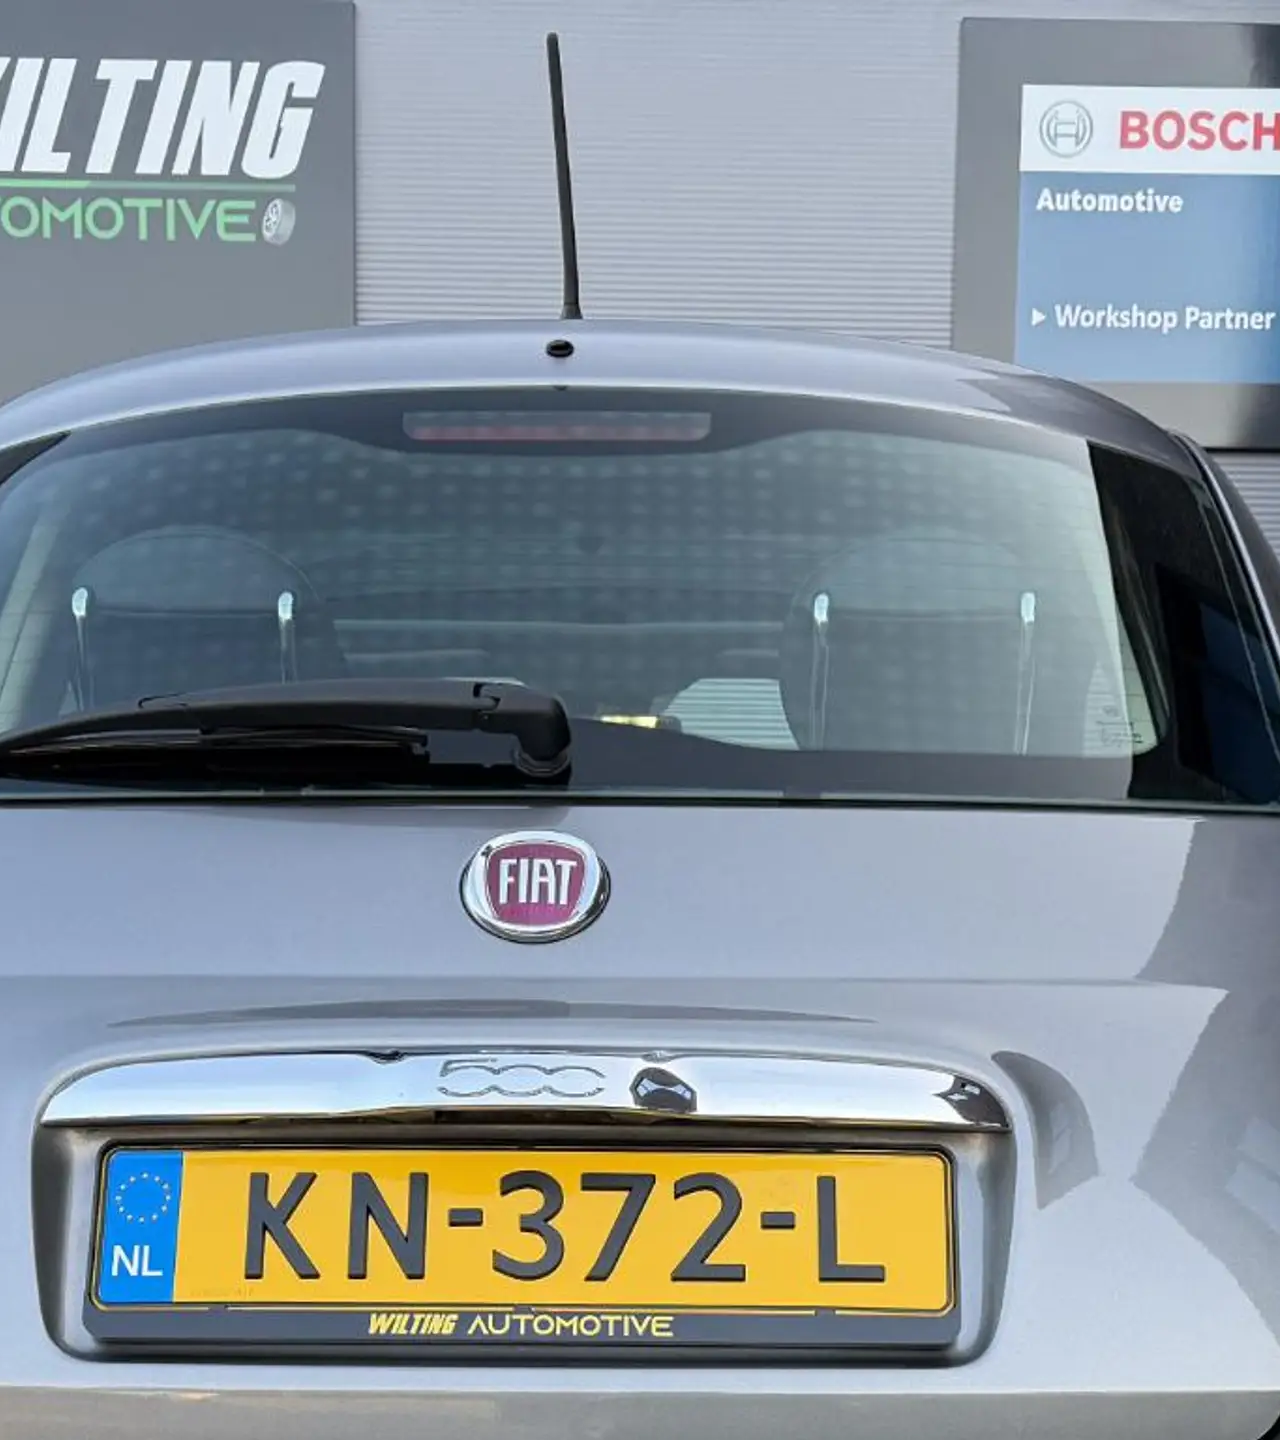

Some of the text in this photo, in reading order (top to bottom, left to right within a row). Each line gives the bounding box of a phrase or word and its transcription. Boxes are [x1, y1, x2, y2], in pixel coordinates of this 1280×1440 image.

[1036, 187, 1183, 213] Automotive
[1054, 304, 1276, 333] Workshop Partner
[499, 858, 577, 905] FIAT
[437, 1057, 606, 1098] 500
[244, 1171, 886, 1283] KN-372-L
[111, 1245, 163, 1277] NL
[367, 1313, 675, 1336] WILTING AUTOMOTIVE
